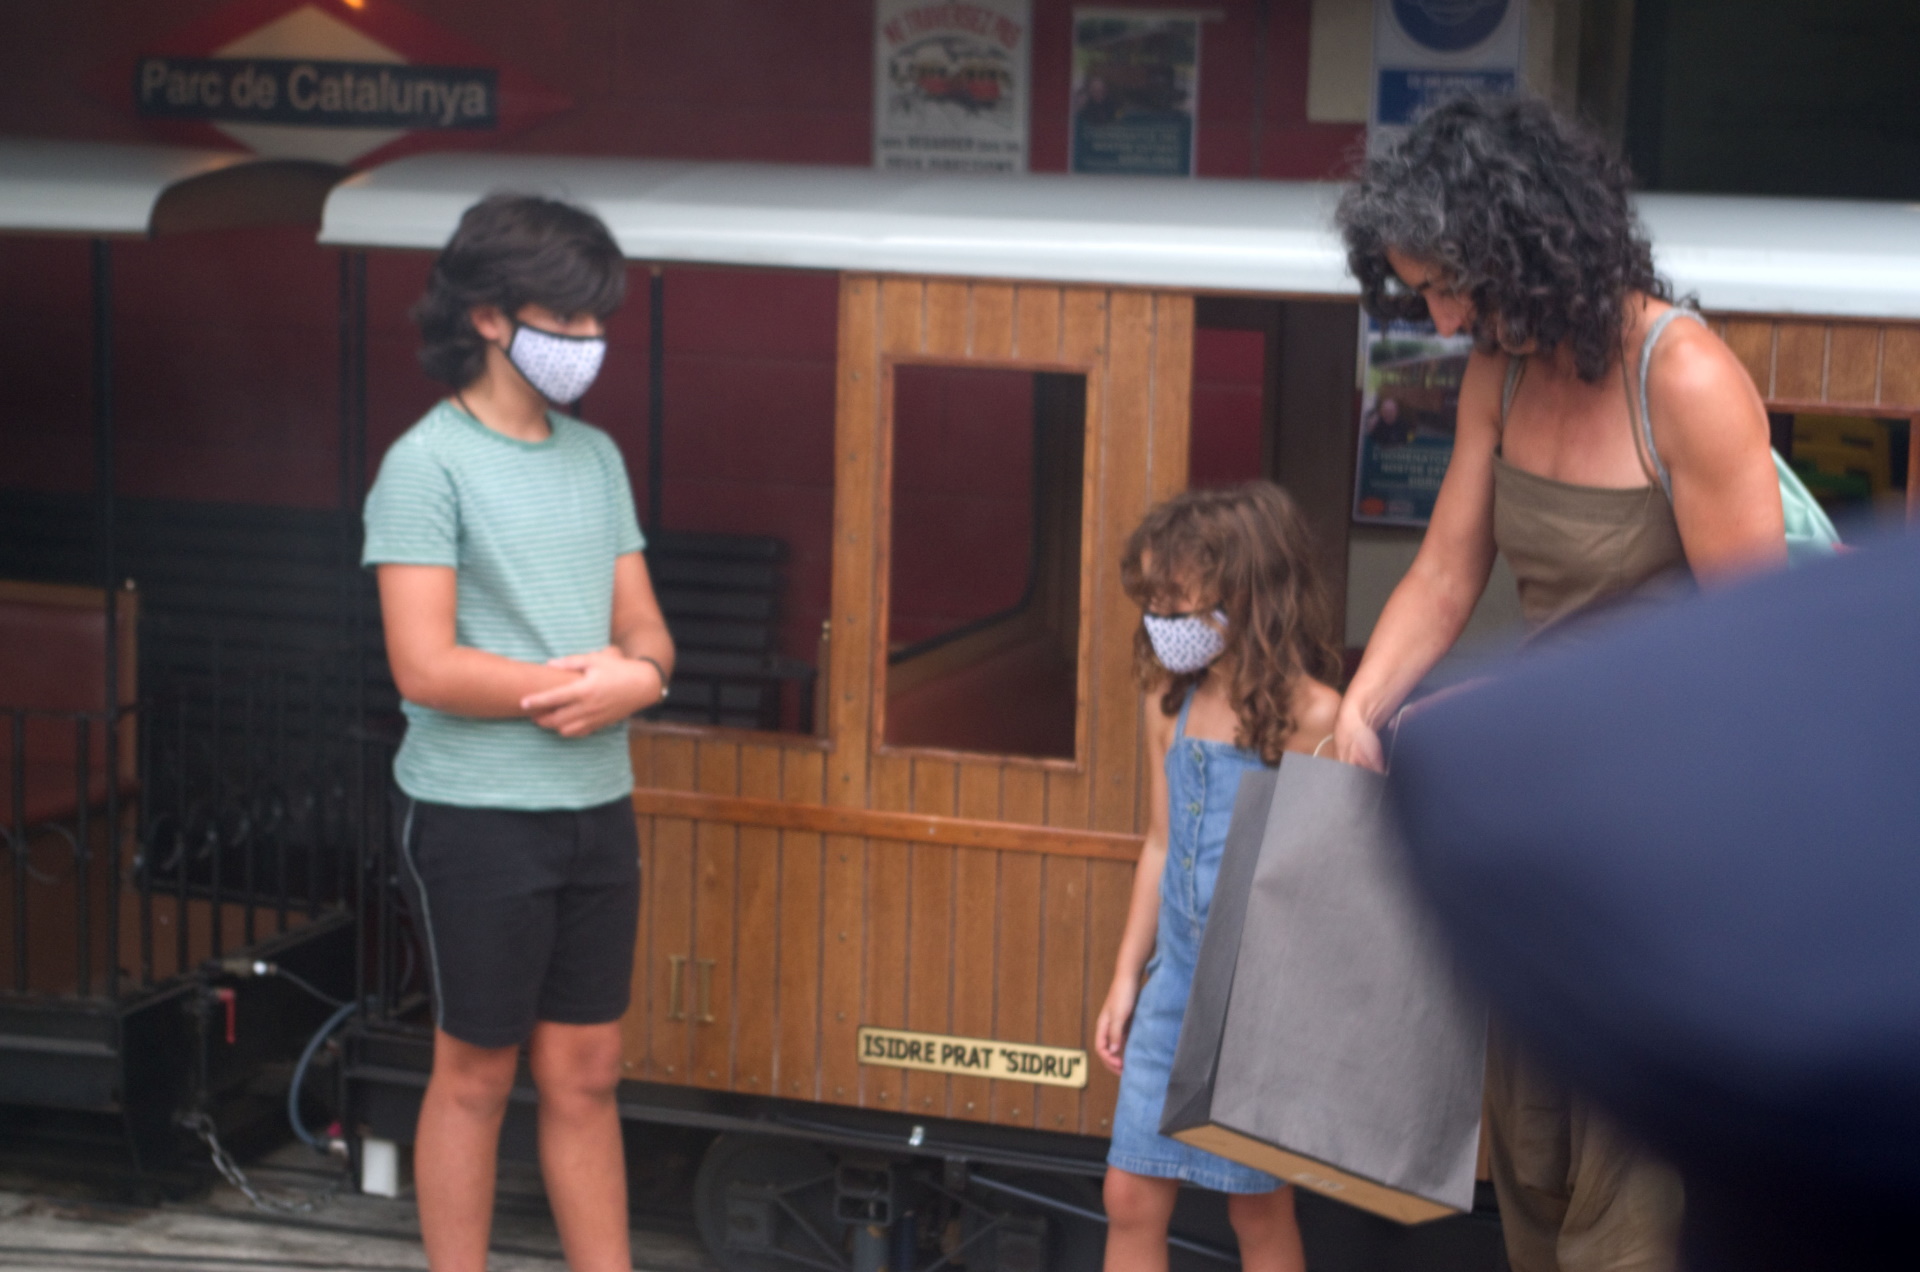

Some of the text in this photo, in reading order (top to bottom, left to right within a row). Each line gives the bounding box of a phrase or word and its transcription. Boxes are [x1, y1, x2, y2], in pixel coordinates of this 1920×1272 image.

[141, 60, 488, 126] Parc de Catalunya
[863, 1034, 1081, 1079] ISIDRE PRAT "SIDRU"
